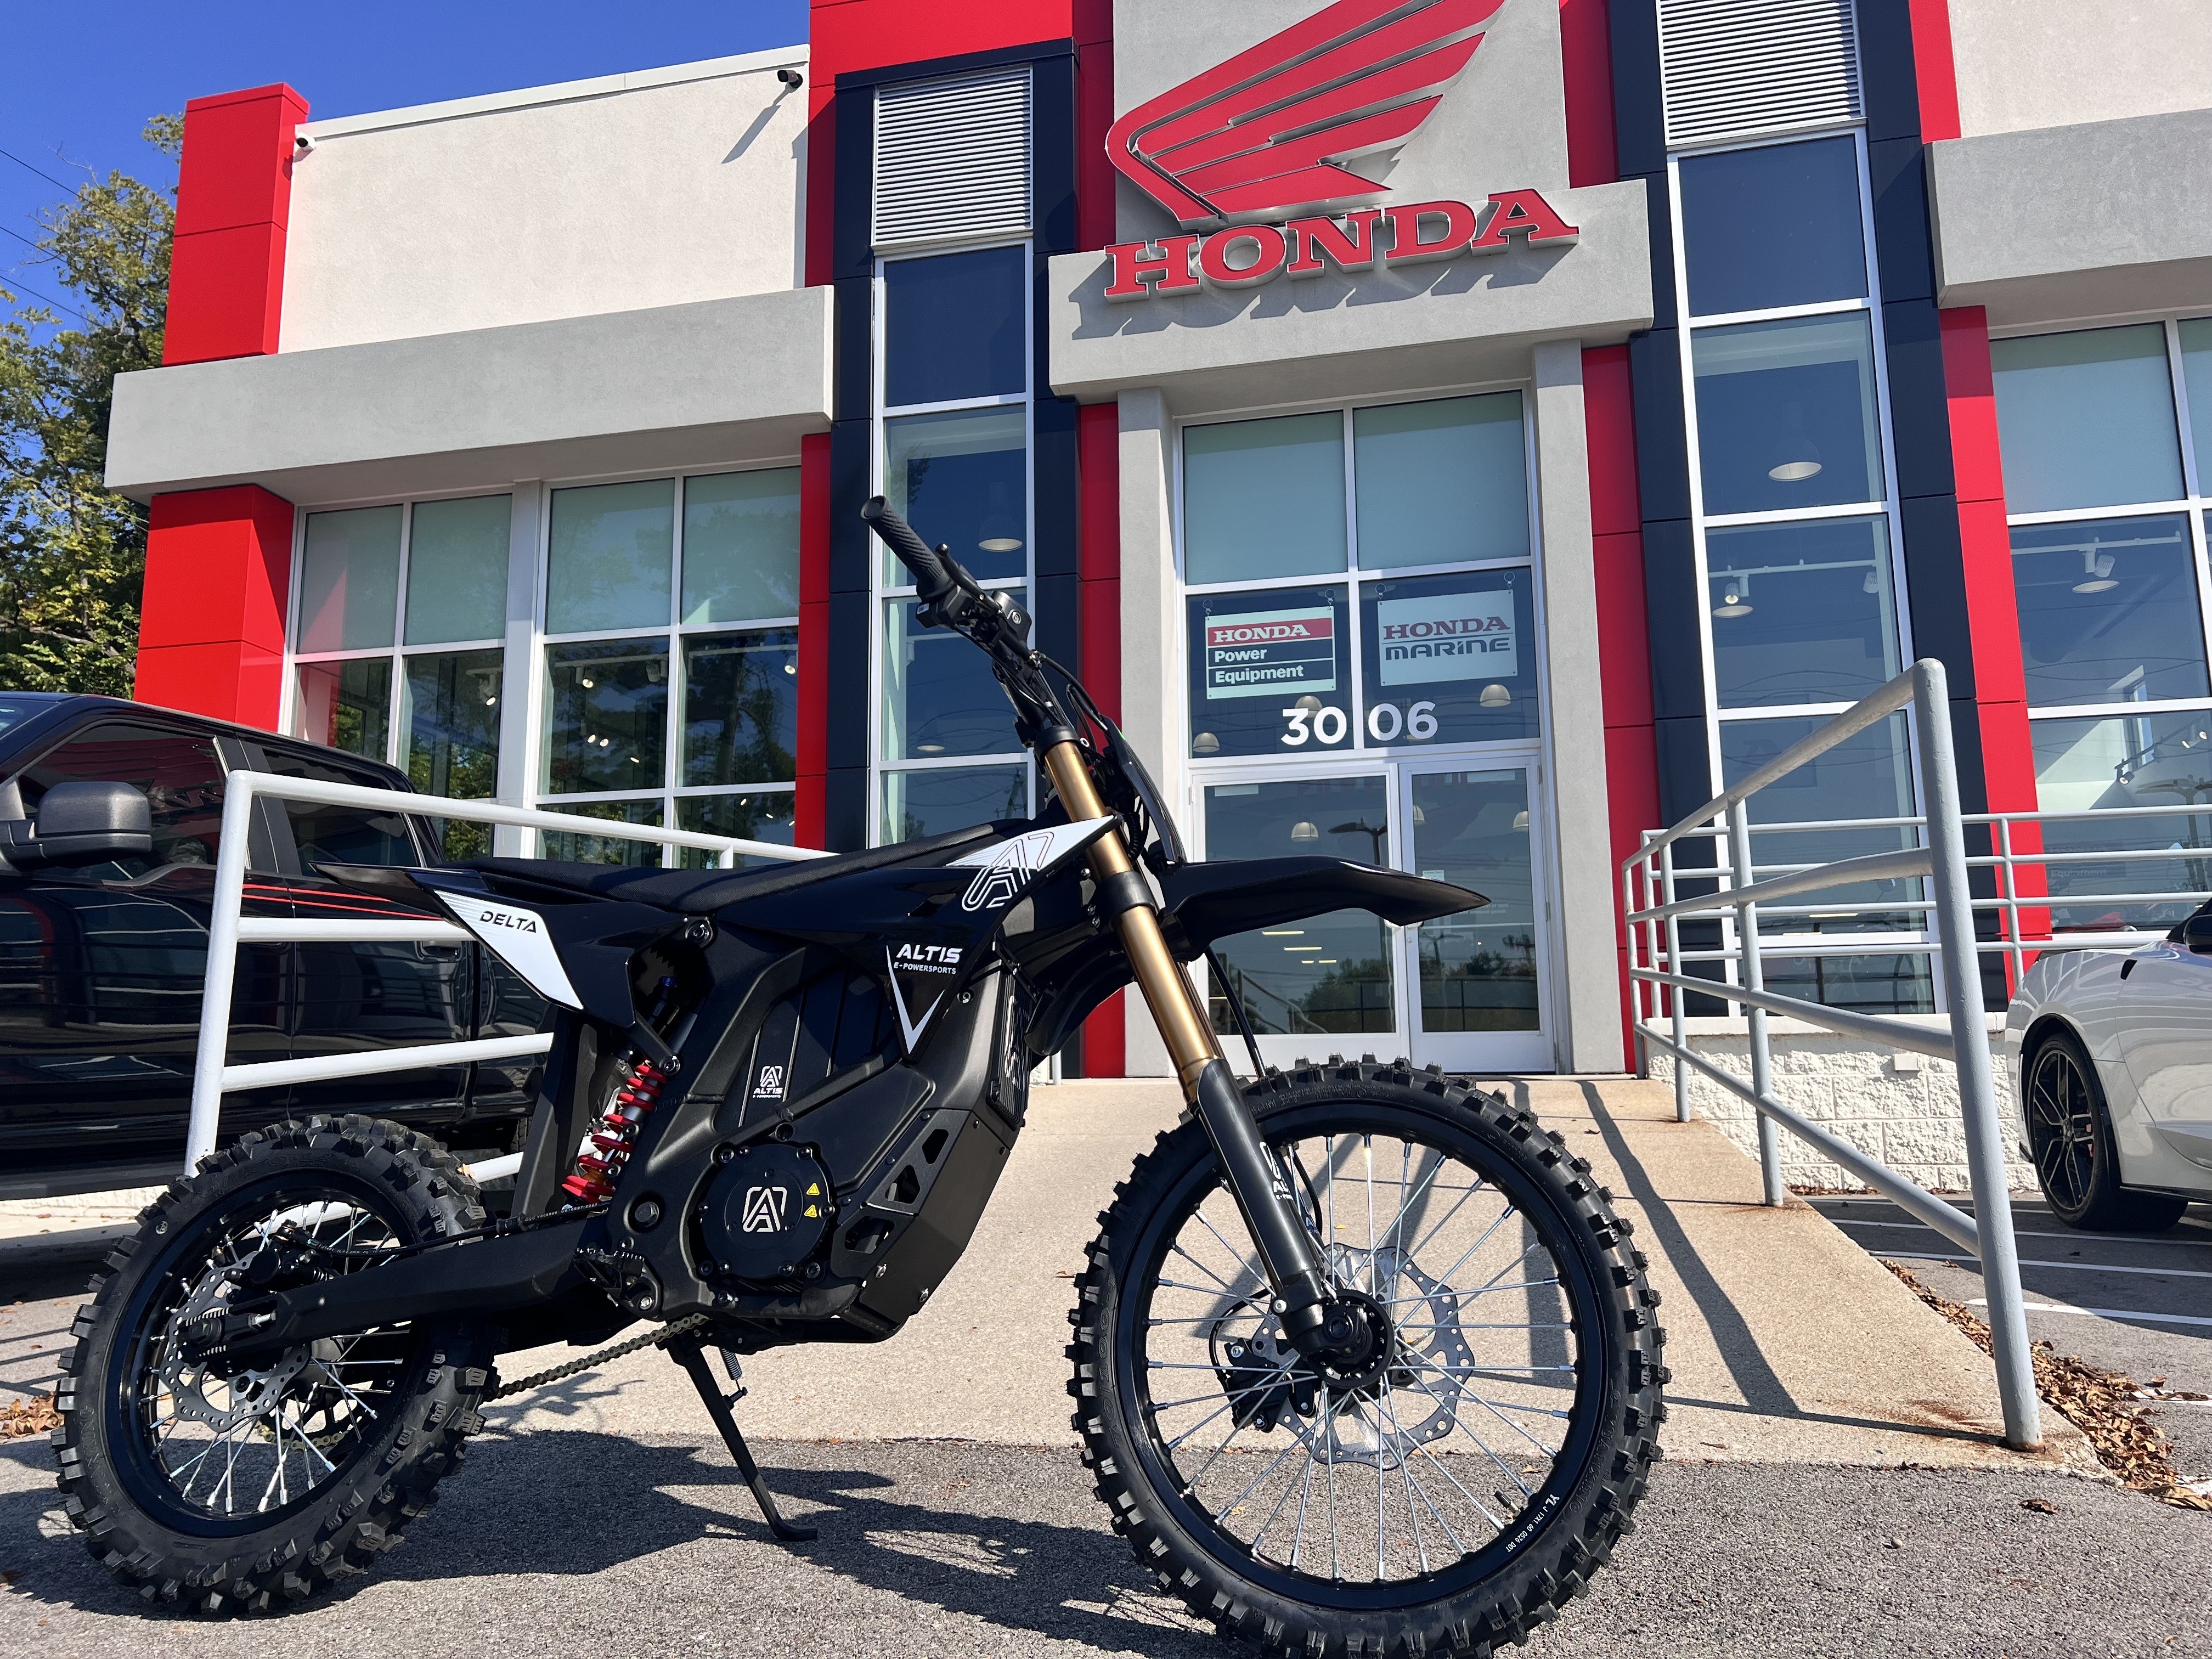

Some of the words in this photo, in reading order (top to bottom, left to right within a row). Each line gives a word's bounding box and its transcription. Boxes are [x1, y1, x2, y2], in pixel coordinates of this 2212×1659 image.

[1104, 188, 1579, 302] HONDA
[1214, 623, 1310, 643] HONDA
[1384, 616, 1510, 640] HONDA
[1215, 647, 1267, 663] Power
[1215, 664, 1304, 684] Equipment
[479, 910, 537, 933] DELTA
[896, 944, 963, 963] ALTIS
[894, 962, 956, 974] E-POWERSPORTS
[1545, 1494, 1560, 1506] YL
[1505, 1541, 1516, 1553] DOT
[1515, 1531, 1528, 1544] 0526
